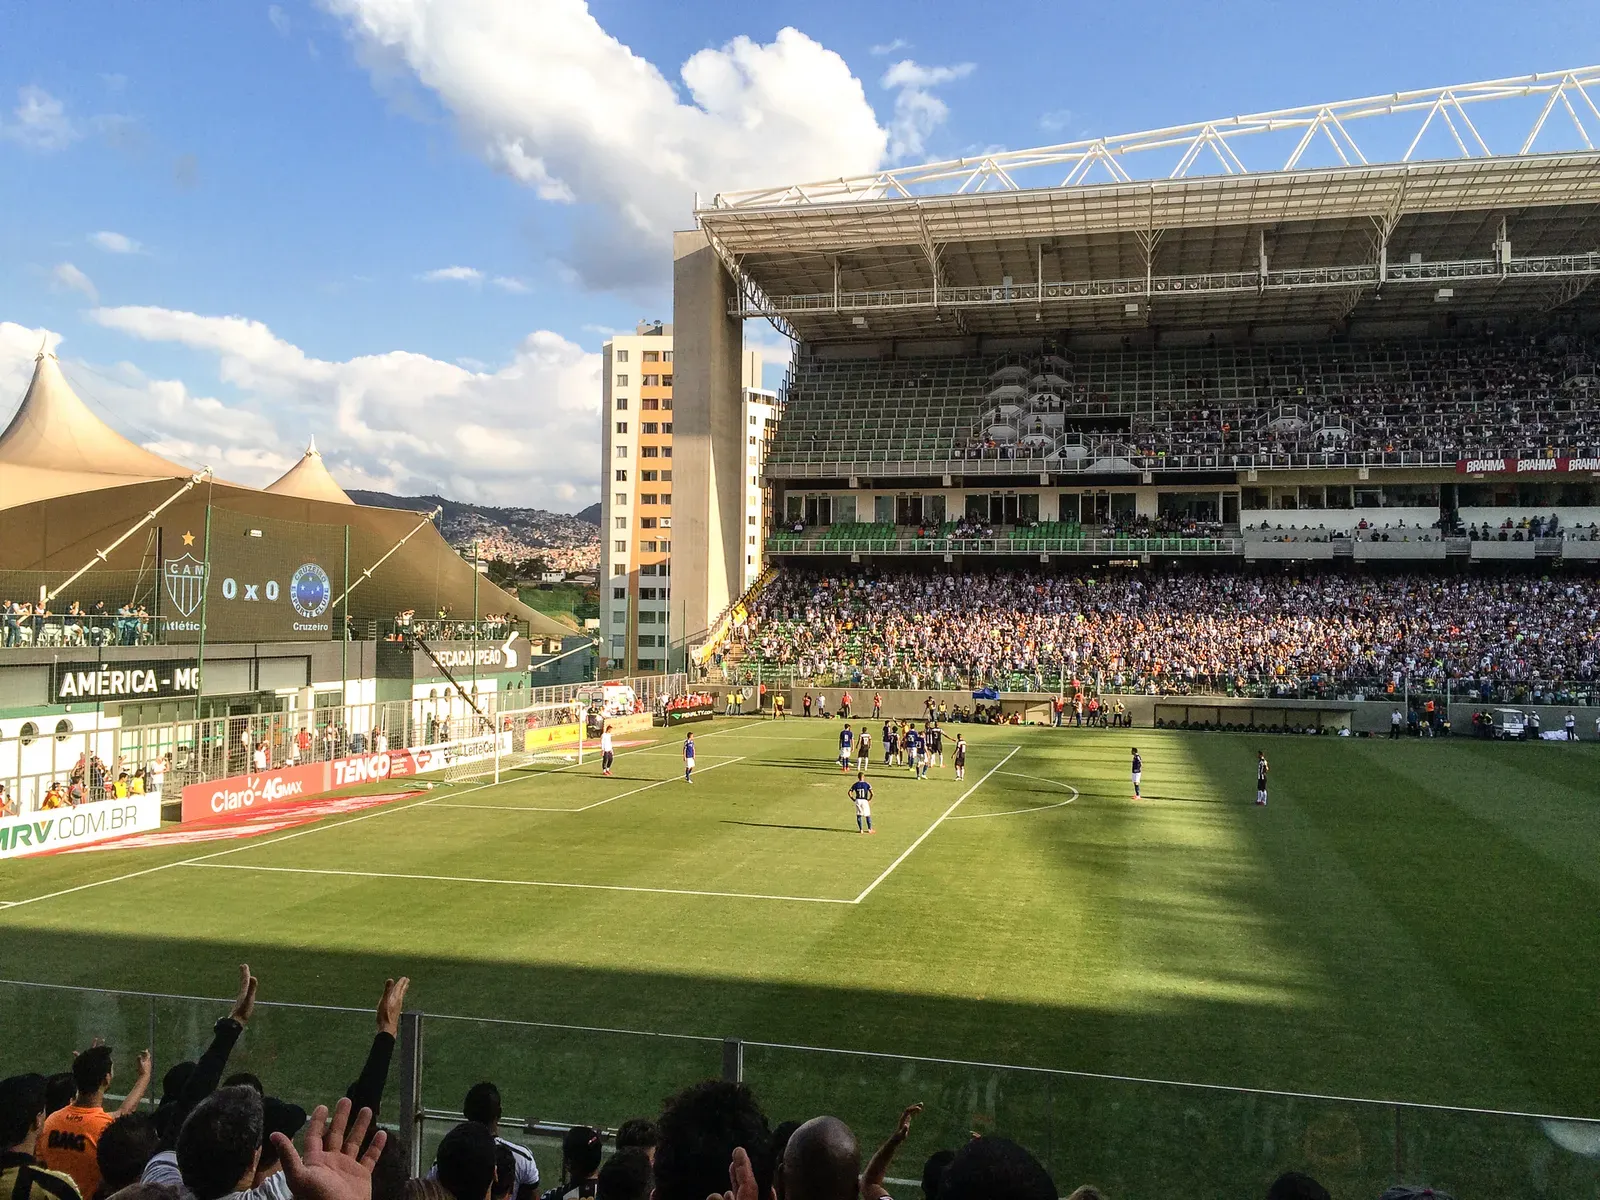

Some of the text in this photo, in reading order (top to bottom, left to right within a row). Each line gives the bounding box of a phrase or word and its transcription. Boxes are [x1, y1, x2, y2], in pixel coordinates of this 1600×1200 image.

[1466, 458, 1600, 473] BRAHMA BRAHMA BRAHM
[294, 565, 327, 583] CRUZEIRO
[222, 577, 280, 601] 0 x 0
[293, 621, 328, 631] Cruzeiro
[59, 663, 158, 697] AMÉRICA
[334, 754, 390, 785] TENCO
